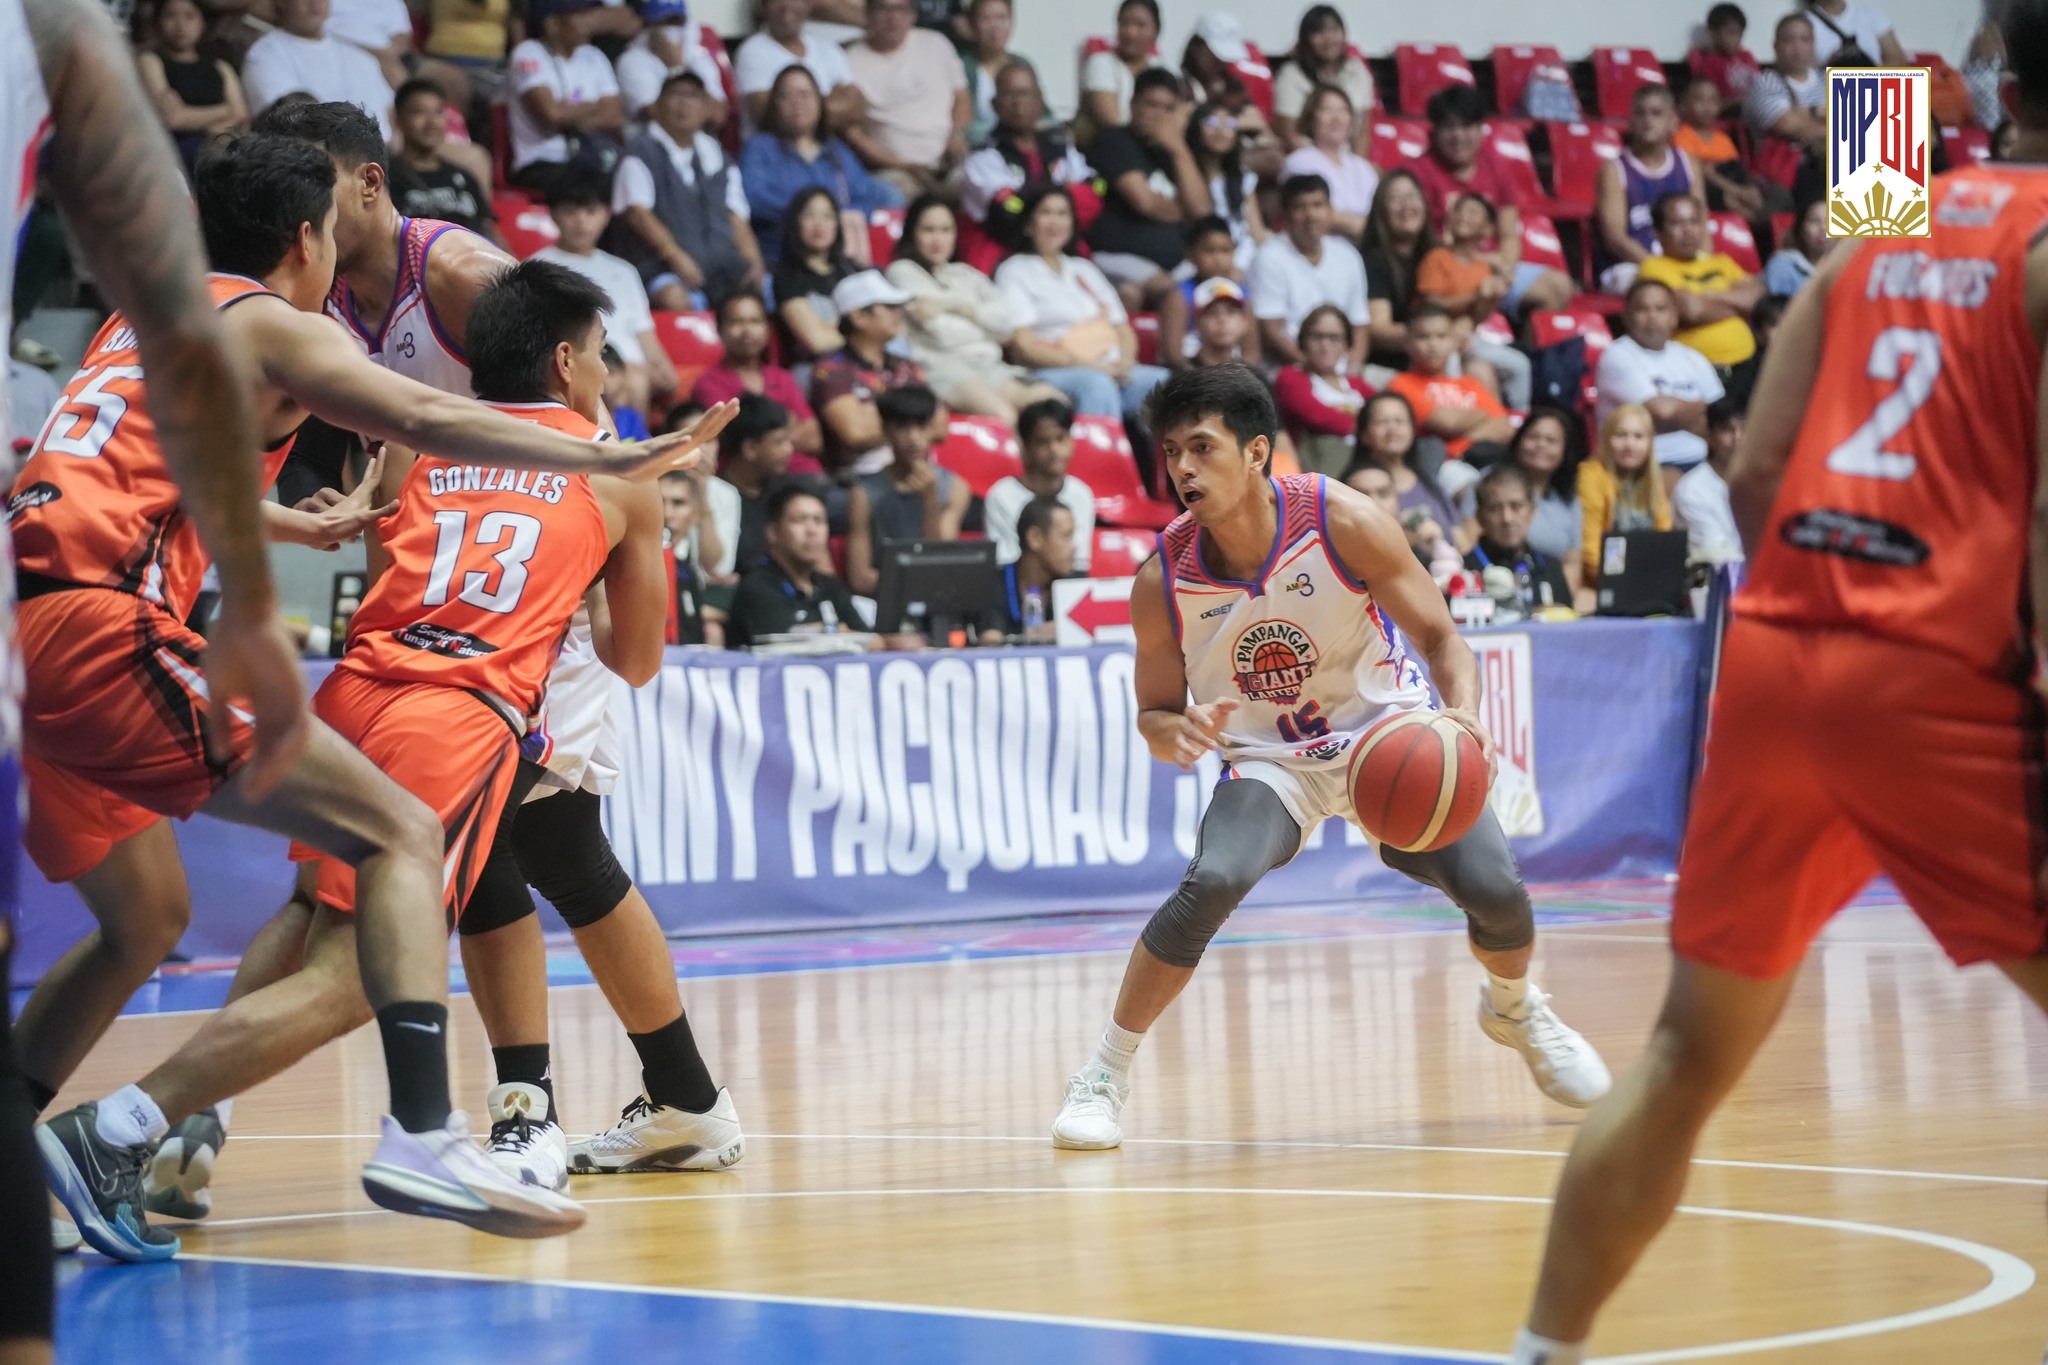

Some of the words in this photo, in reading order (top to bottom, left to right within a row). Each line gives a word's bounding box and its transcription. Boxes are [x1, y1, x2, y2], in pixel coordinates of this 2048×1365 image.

[1826, 325, 1943, 481] 2
[428, 465, 569, 505] GONZALES
[422, 510, 543, 614] 13
[397, 628, 433, 649] Tunay
[448, 640, 490, 657] Natur
[1237, 624, 1311, 662] PAMPANGA
[1247, 664, 1312, 692] GIANT
[602, 664, 765, 886] NNY
[783, 652, 1151, 892] PACQUIAO
